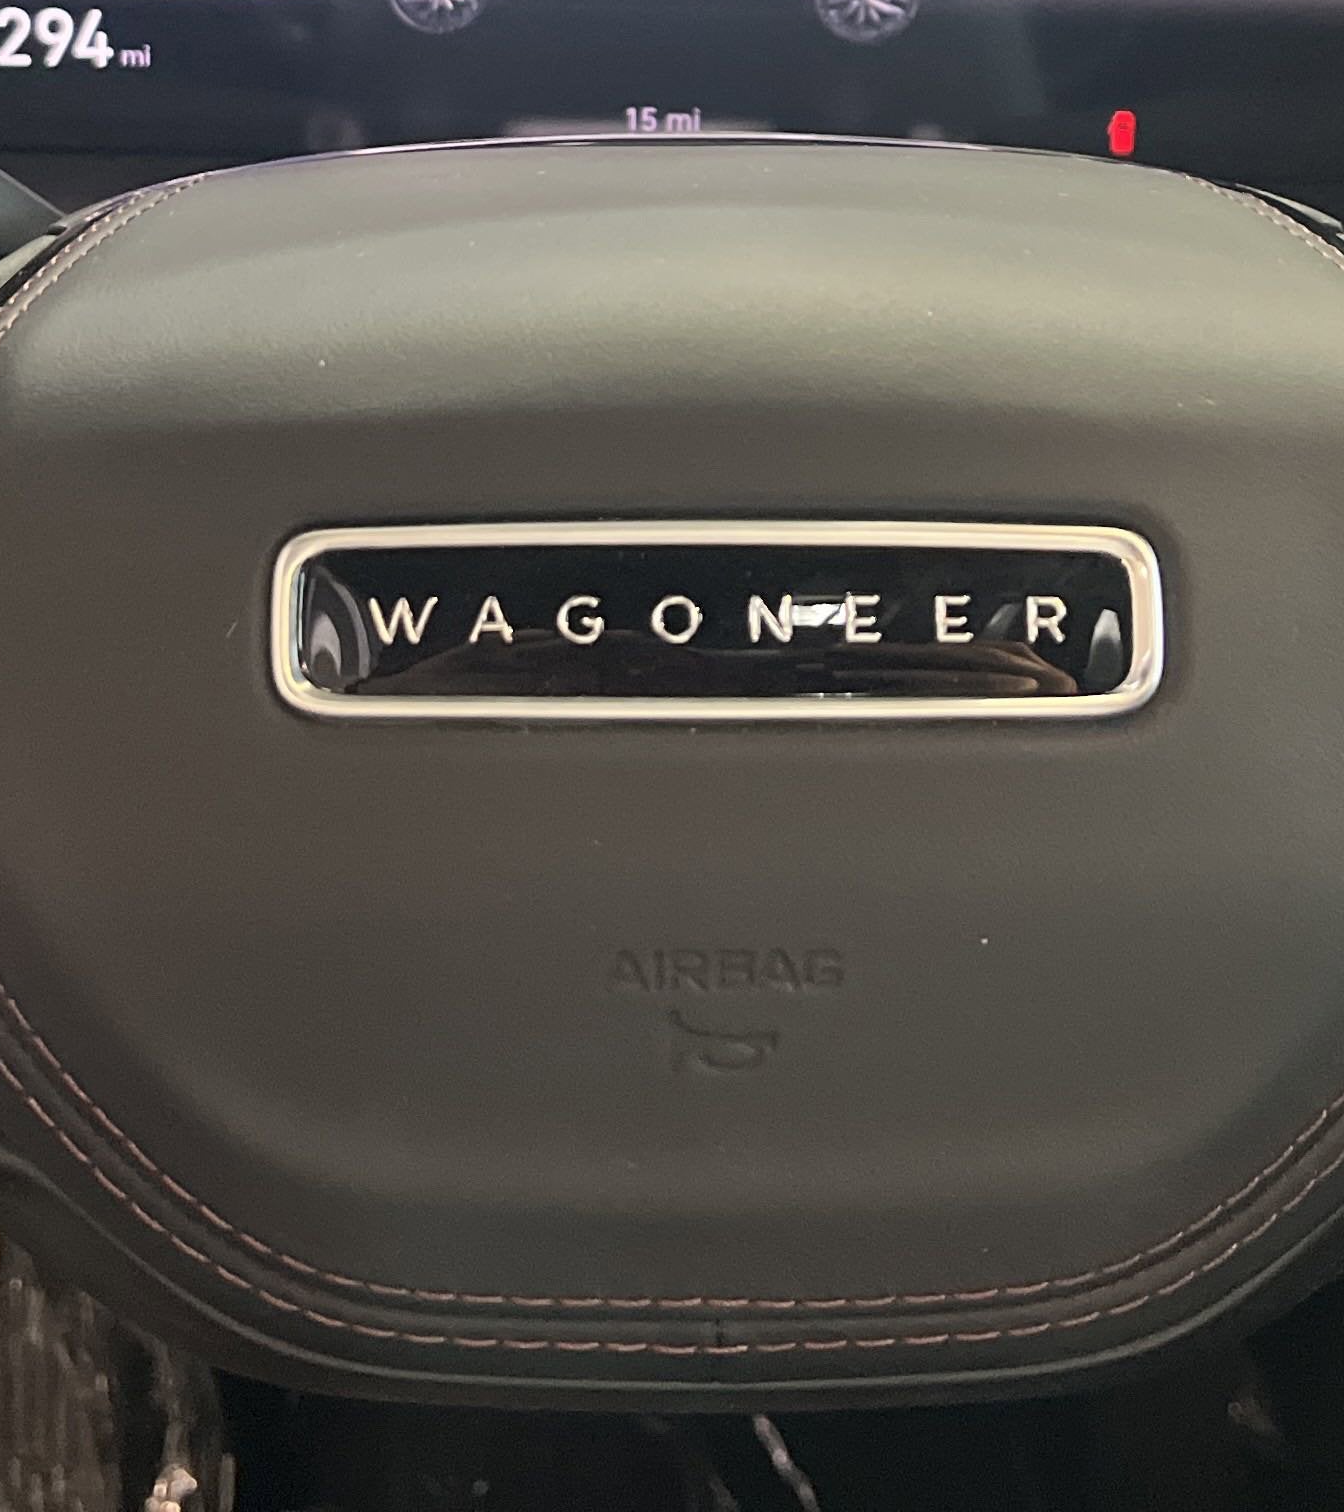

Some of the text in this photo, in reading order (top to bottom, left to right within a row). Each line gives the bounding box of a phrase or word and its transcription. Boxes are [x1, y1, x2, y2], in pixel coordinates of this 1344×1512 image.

[119, 45, 152, 68] mi
[625, 105, 702, 132] 15 mi
[368, 594, 1070, 644] WAGONEER
[610, 947, 846, 991] AIRBAG
